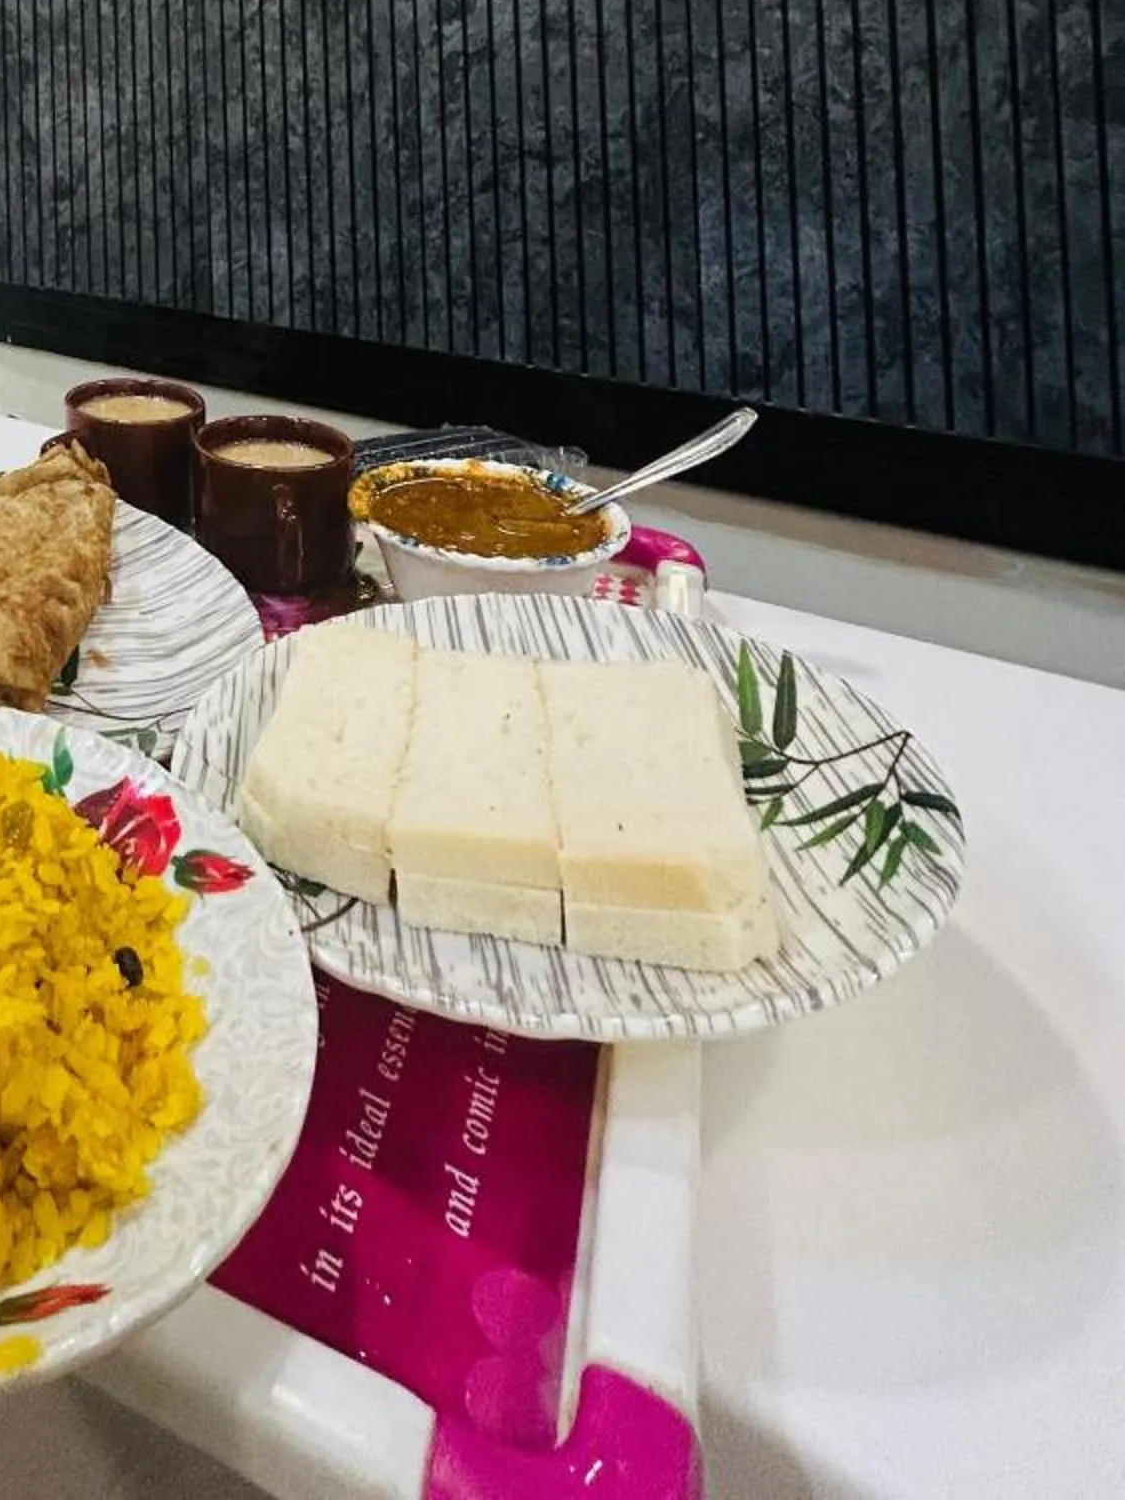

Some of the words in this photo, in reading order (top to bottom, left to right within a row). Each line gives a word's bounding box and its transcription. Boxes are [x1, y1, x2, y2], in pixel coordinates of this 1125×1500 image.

[338, 1087, 392, 1171] ideal
[462, 1066, 500, 1156] comic
[318, 1183, 364, 1235] its
[444, 1162, 481, 1238] and
[300, 1248, 344, 1293] in
